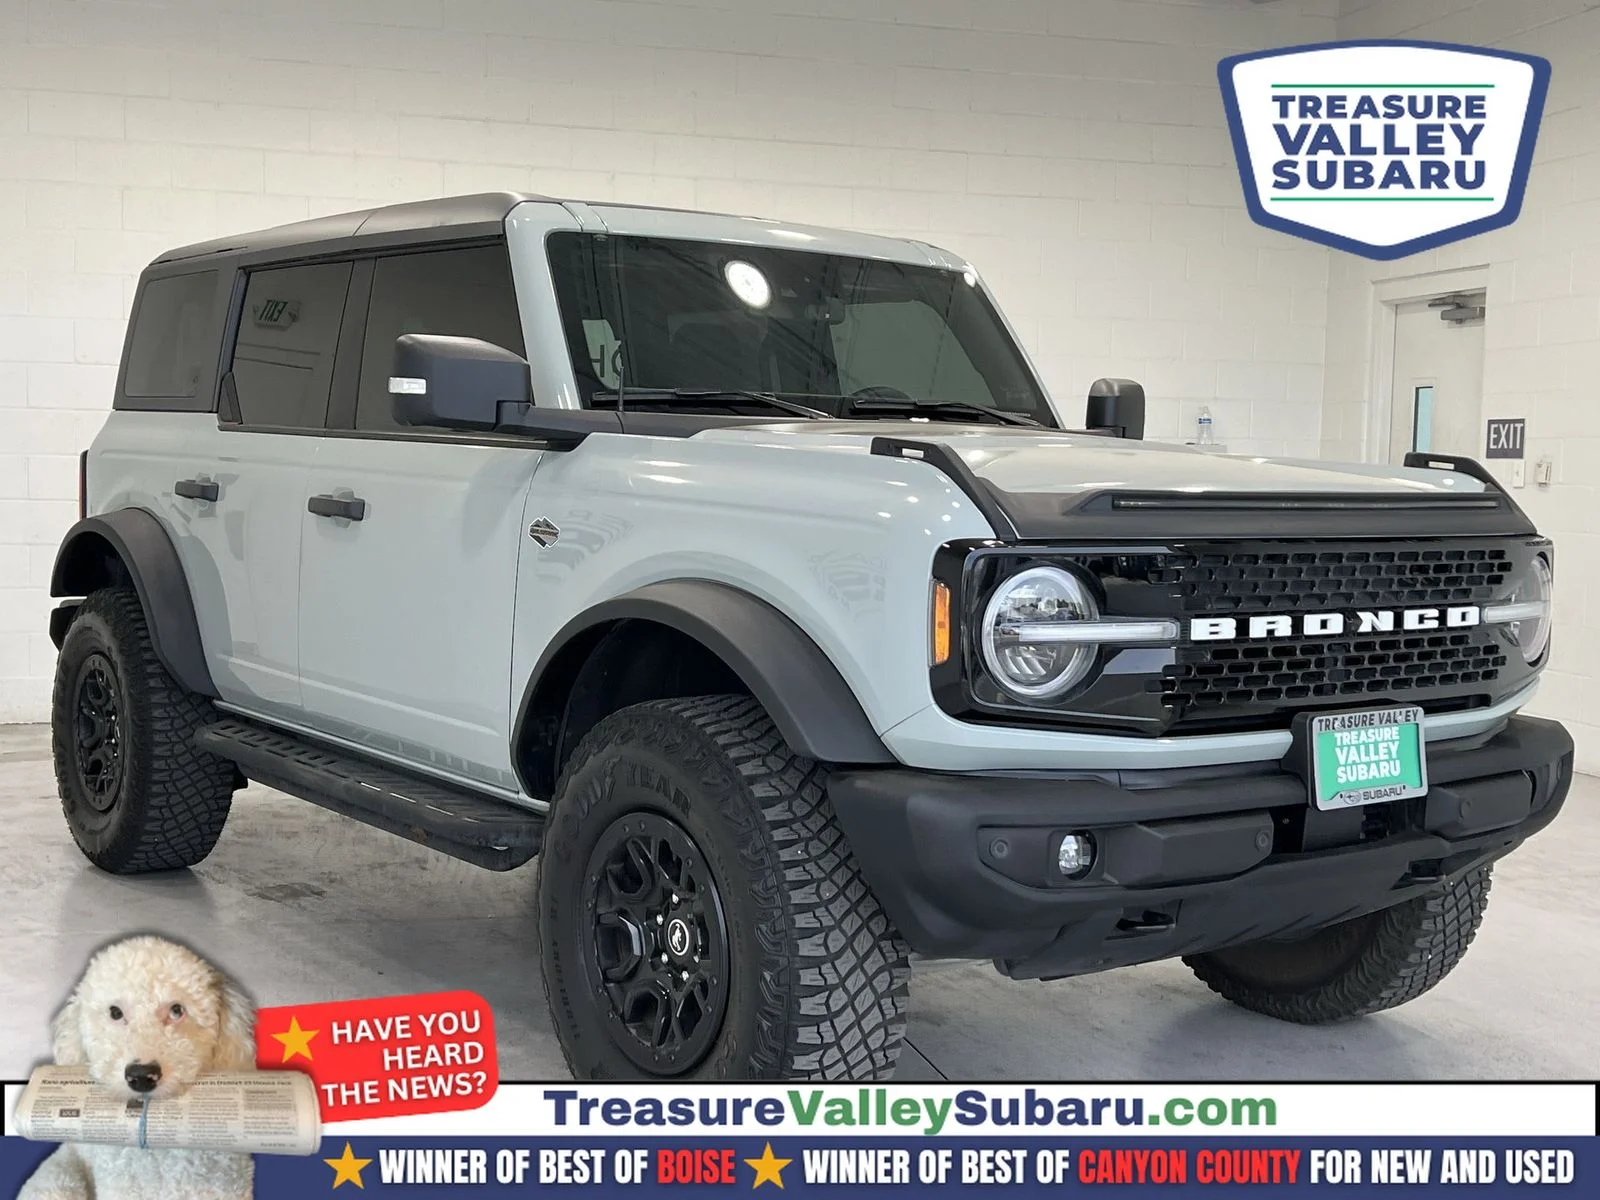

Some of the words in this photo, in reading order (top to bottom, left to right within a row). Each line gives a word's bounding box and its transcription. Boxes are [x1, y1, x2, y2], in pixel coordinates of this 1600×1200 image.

[1489, 423, 1524, 449] EXIT
[1190, 605, 1480, 641] BRONCO
[1318, 712, 1375, 732] TREASURE
[1334, 726, 1400, 747] TREASURE
[1335, 741, 1400, 765] VALLEY
[1336, 760, 1401, 784] SUBARU
[1362, 786, 1403, 801] SUBARU
